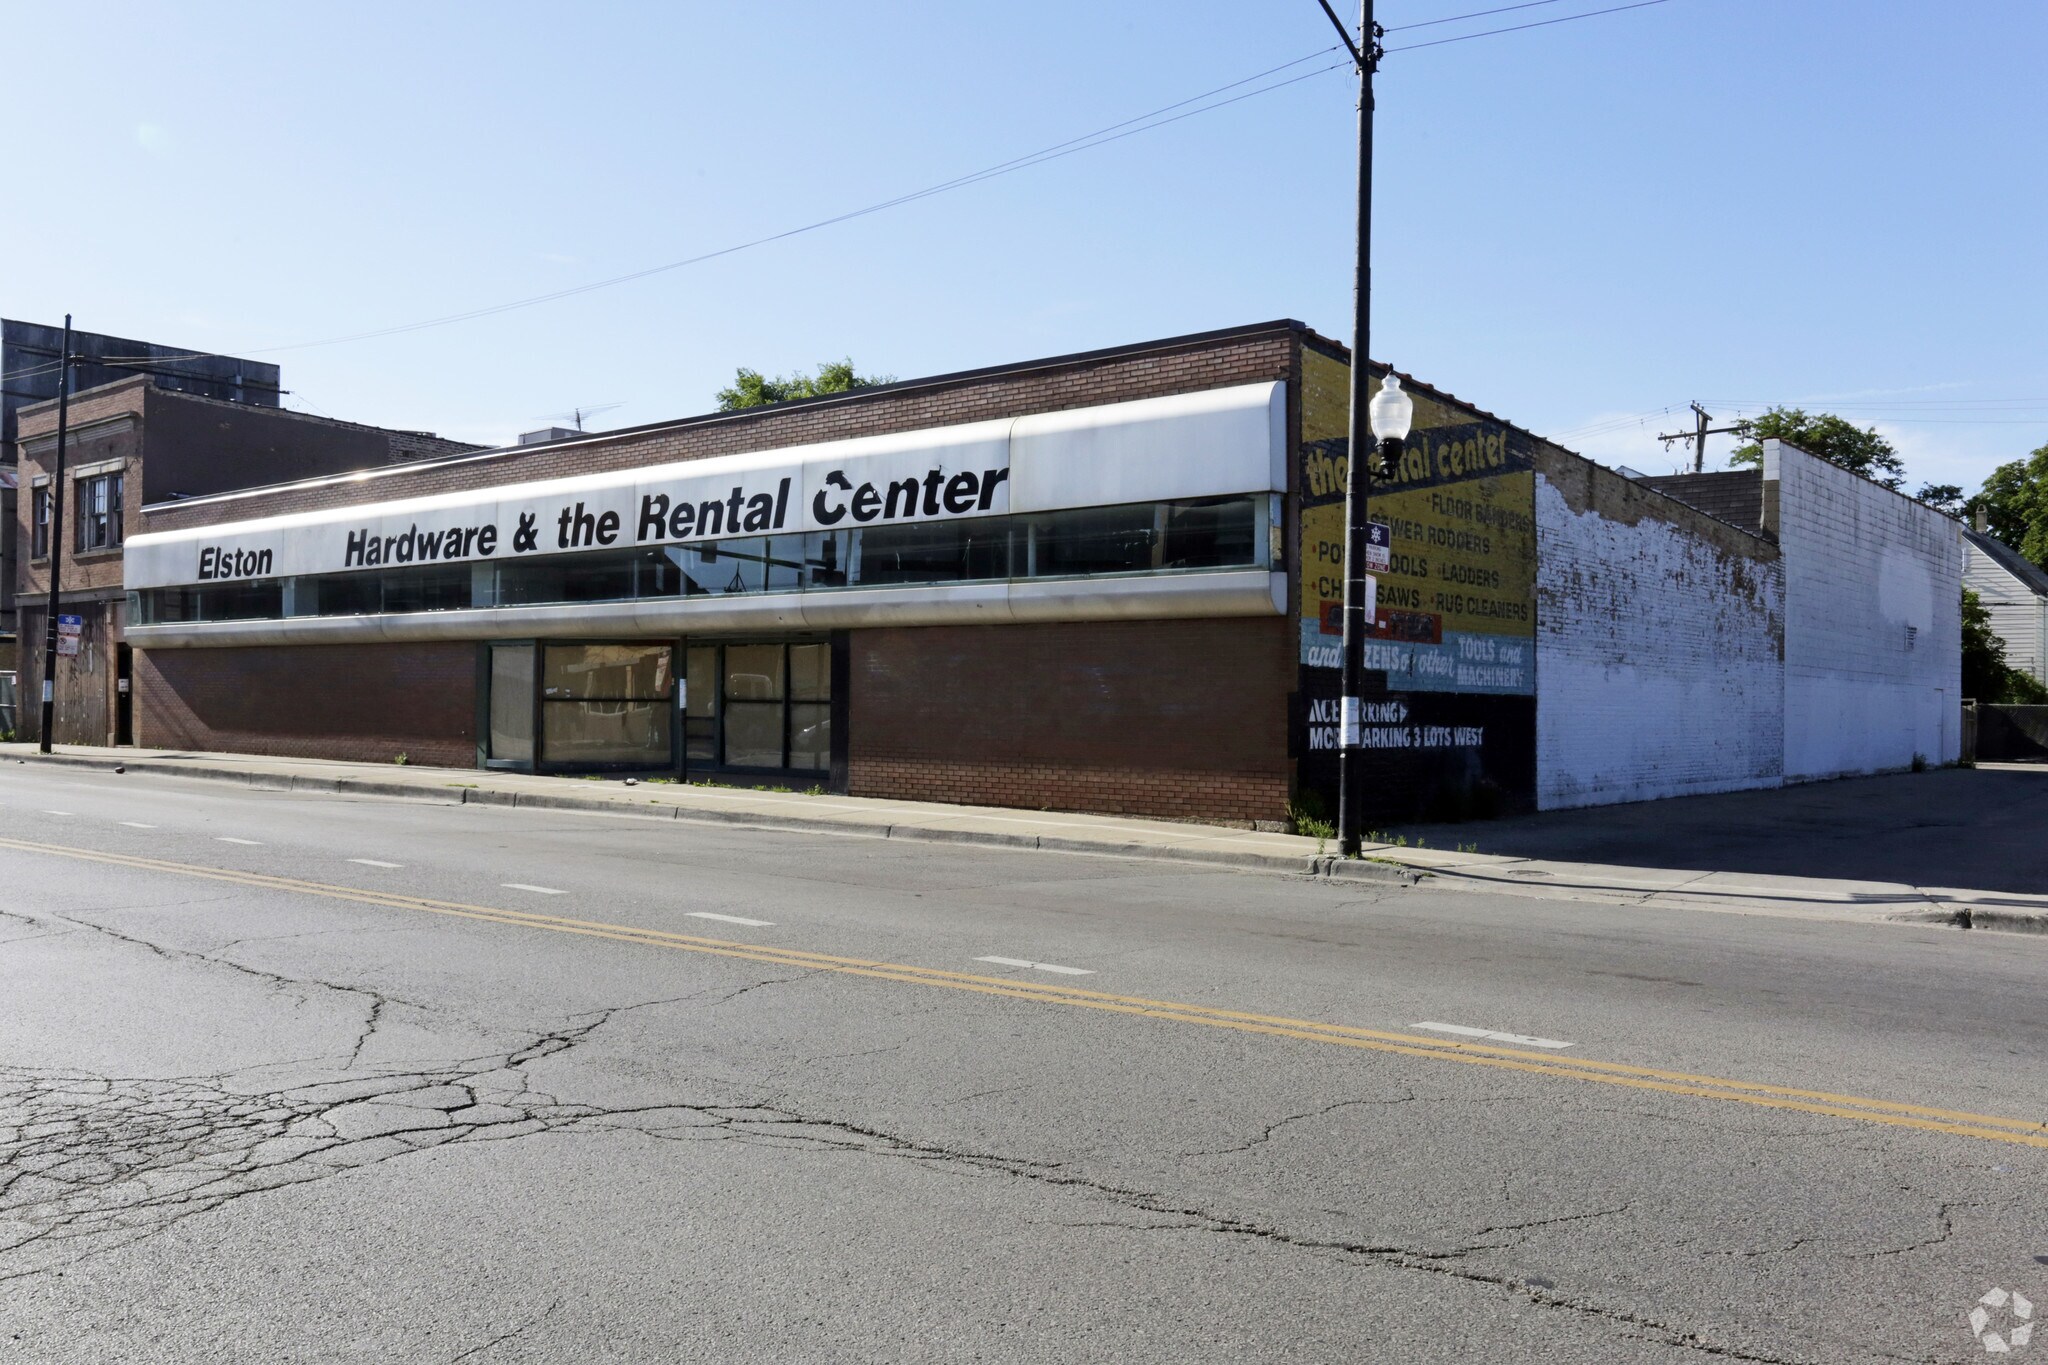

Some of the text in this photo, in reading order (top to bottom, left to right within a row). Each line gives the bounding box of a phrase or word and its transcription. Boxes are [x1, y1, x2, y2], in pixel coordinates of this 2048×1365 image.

[1306, 447, 1348, 496] the
[1437, 429, 1506, 476] center
[1432, 493, 1472, 520] FLOOR
[198, 465, 1010, 580] Elston Hardware & the Rental Center
[1428, 525, 1490, 554] RODDERS
[1390, 552, 1499, 590] OOLS LADDERS
[1376, 584, 1420, 608] SAWS
[1436, 592, 1529, 622] RUG CLEANERS
[1307, 642, 1342, 669] and
[1363, 645, 1399, 670] ZENS
[1418, 648, 1455, 678] other
[1458, 635, 1522, 664] TOOLS and
[1457, 665, 1524, 688] MACHINERY
[1309, 698, 1397, 723] ACE RKING
[1309, 726, 1342, 750] MOR
[1361, 727, 1411, 749] ARKING
[1413, 726, 1421, 747] 3
[1423, 726, 1452, 747] LOTS
[1454, 725, 1484, 747] WEST
